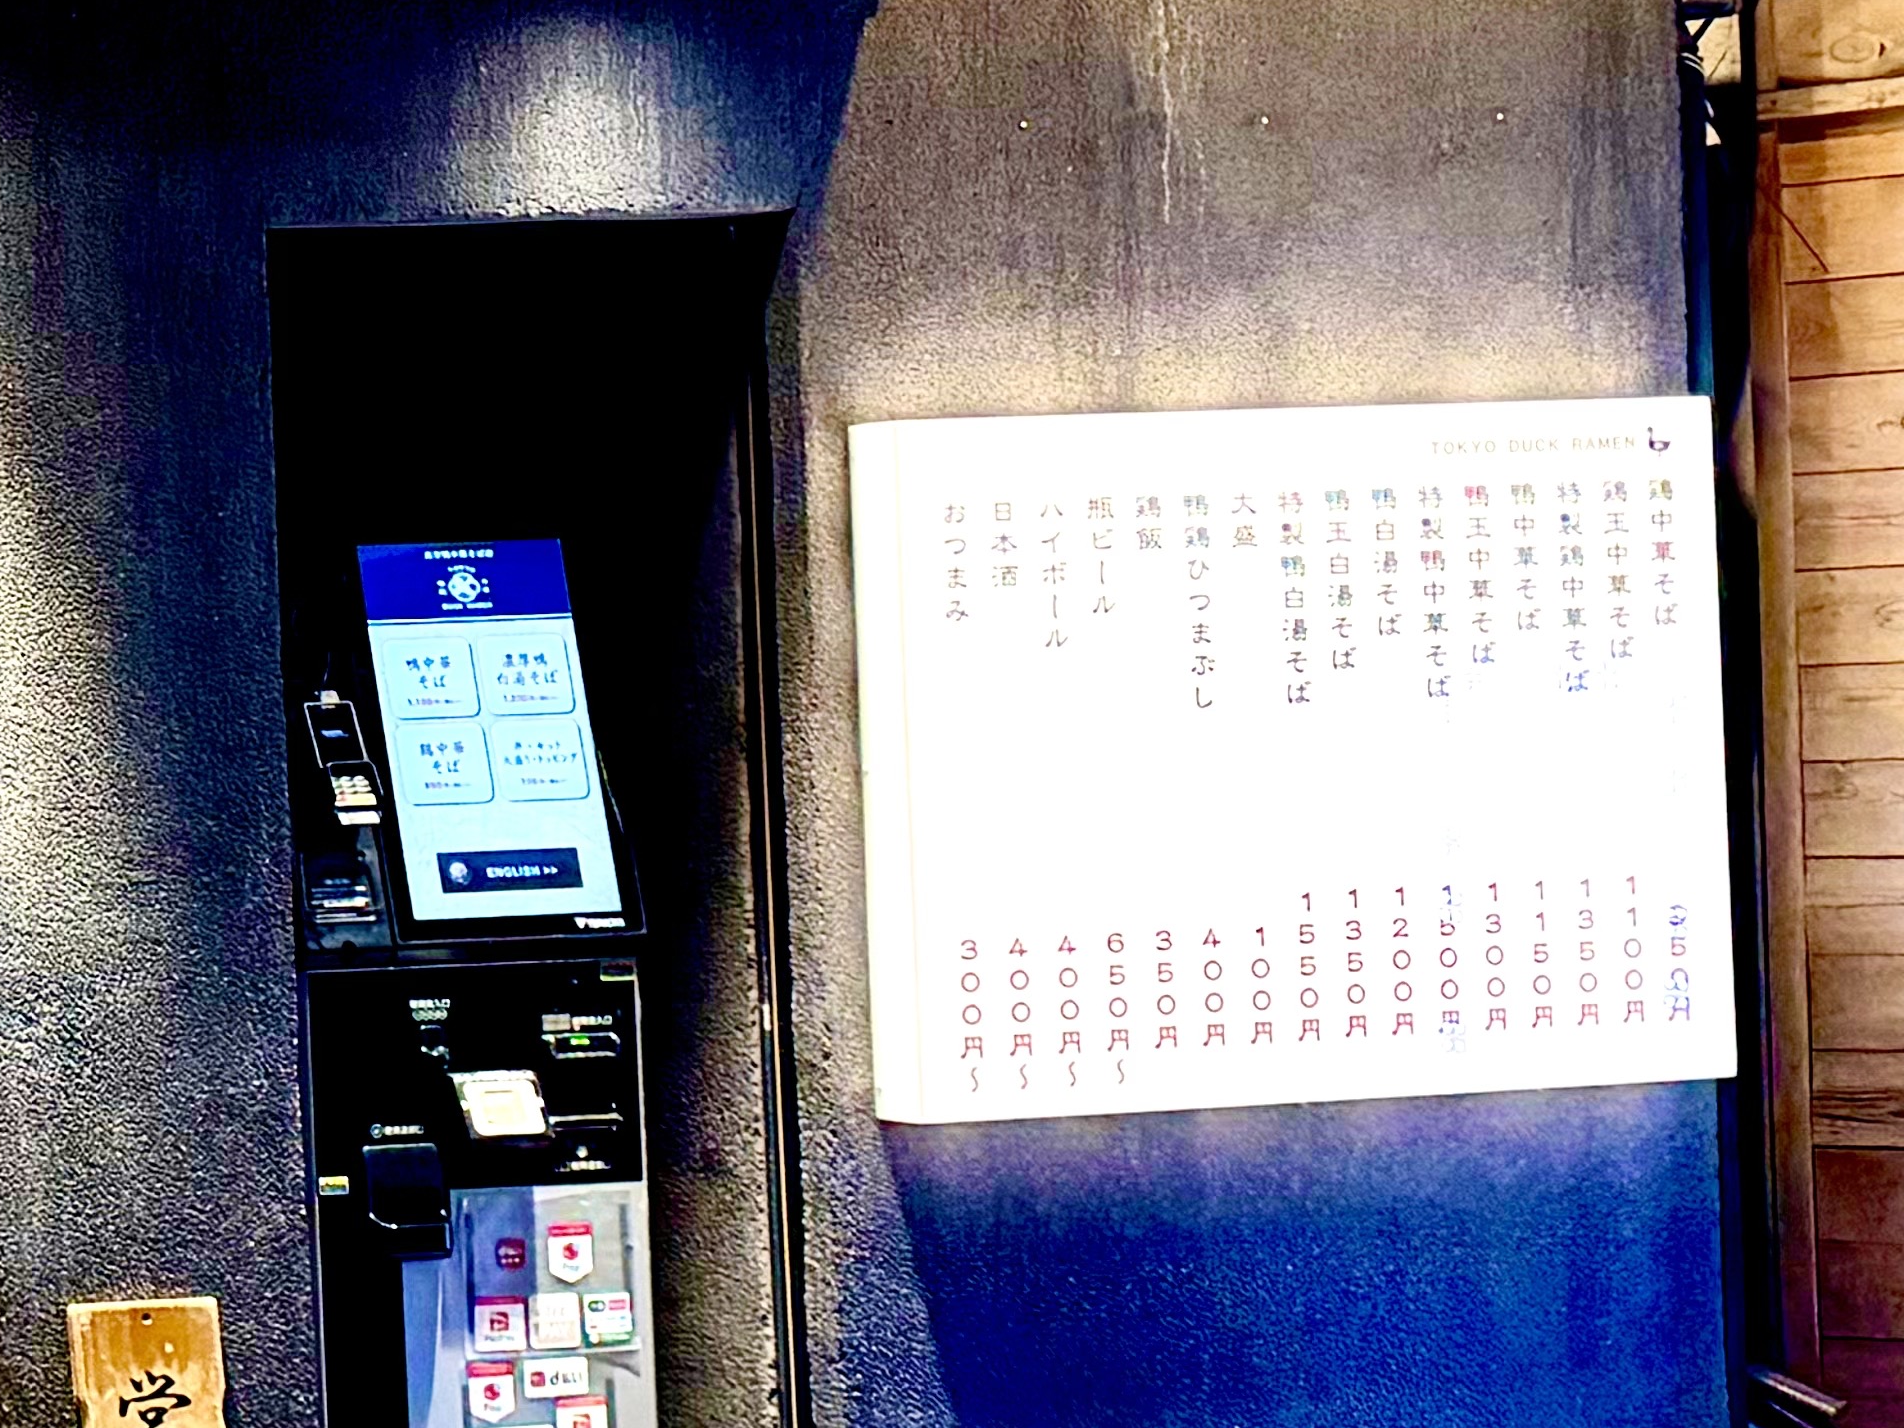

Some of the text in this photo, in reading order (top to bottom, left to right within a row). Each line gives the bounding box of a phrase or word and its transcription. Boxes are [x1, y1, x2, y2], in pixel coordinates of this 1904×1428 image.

[1432, 436, 1635, 455] TOKYO DUCK RAMEN
[945, 505, 968, 621] おつまみ
[991, 502, 1018, 587] 日本酒
[1041, 505, 1068, 647] ハイボール
[1088, 497, 1115, 613] 瓶ビール
[1232, 494, 1257, 547] 大盛
[1155, 930, 1177, 1049] 350円
[1202, 928, 1225, 1047] 400円
[1251, 927, 1272, 1044] 100円
[1298, 892, 1320, 1042] 1550円
[1345, 889, 1367, 1038] 1350円
[1392, 887, 1414, 1036] 1200円
[1485, 882, 1506, 1031] 1300円
[1532, 881, 1552, 1028] 1150円
[1577, 879, 1599, 1026] 1350円
[1623, 876, 1644, 1023] 1100円
